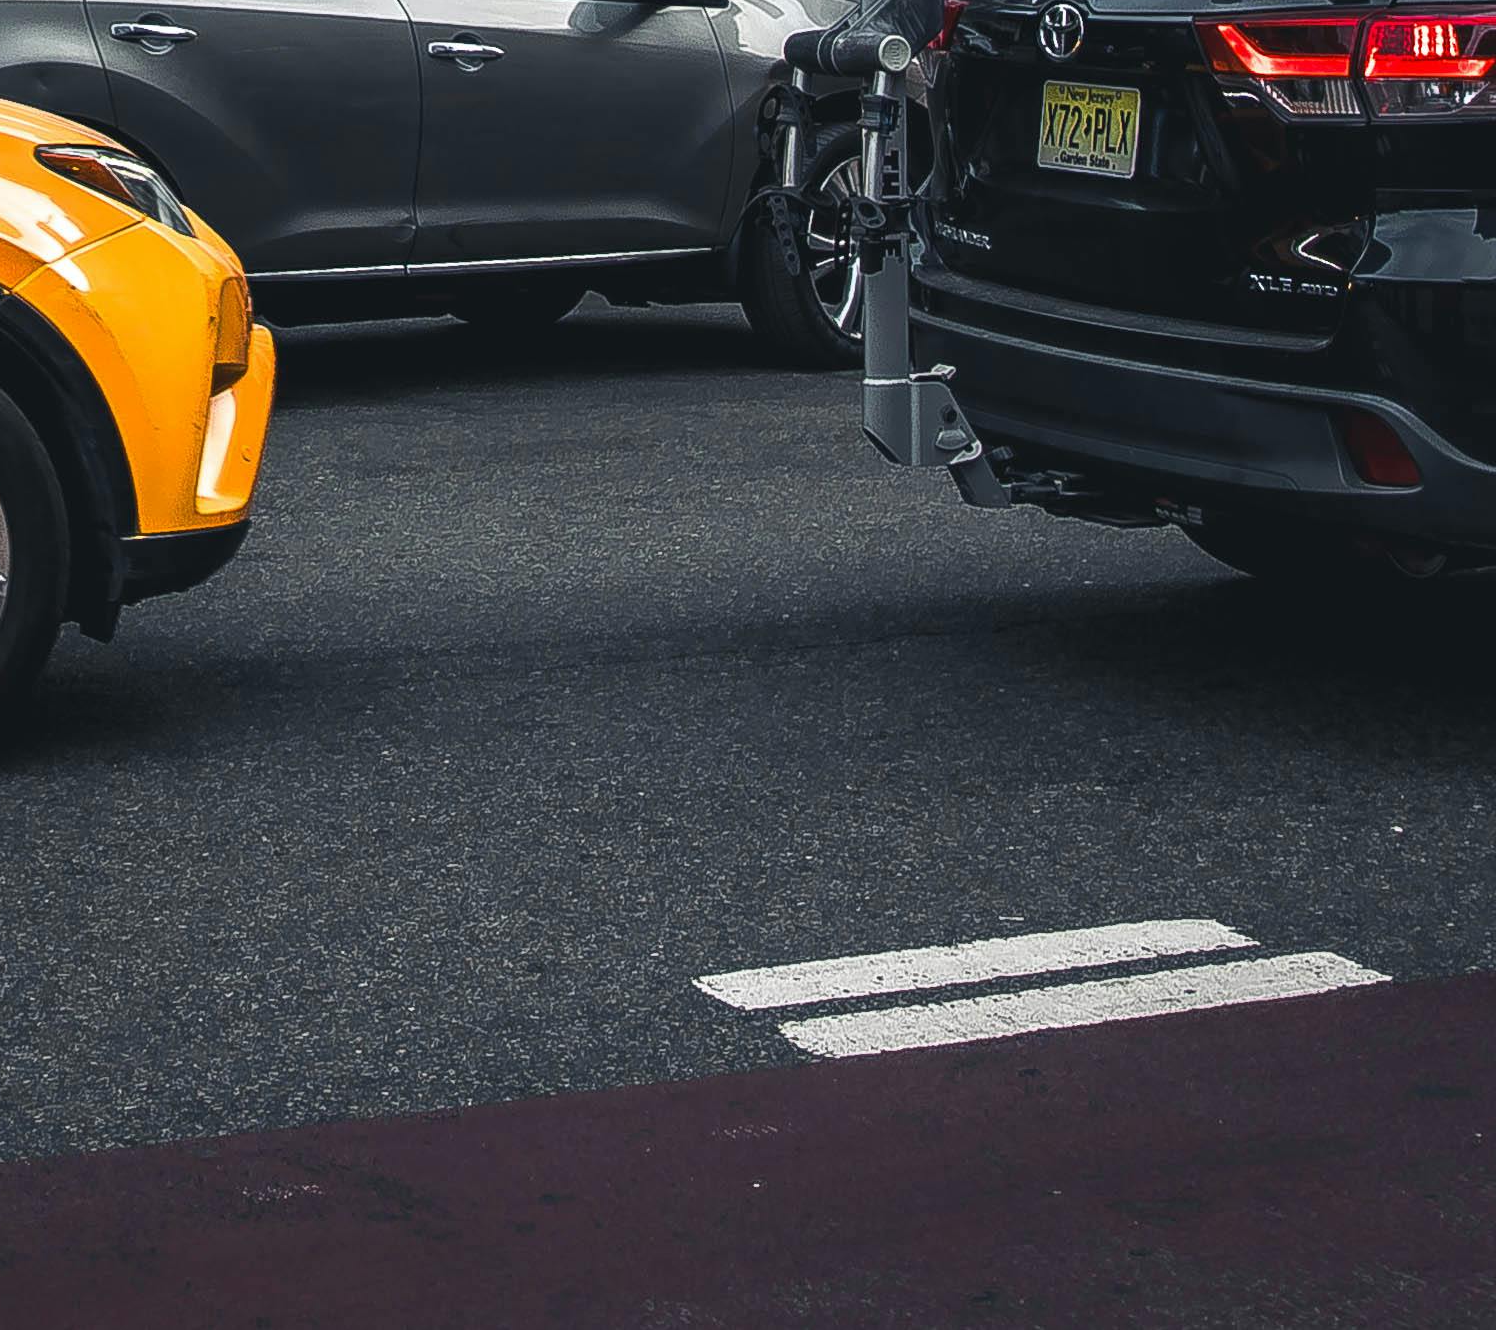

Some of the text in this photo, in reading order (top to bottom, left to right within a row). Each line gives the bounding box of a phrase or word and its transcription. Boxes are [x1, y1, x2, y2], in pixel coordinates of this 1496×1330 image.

[1087, 87, 1115, 108] Jersey
[1059, 150, 1111, 169] Garden State
[1250, 274, 1292, 293] XLE
